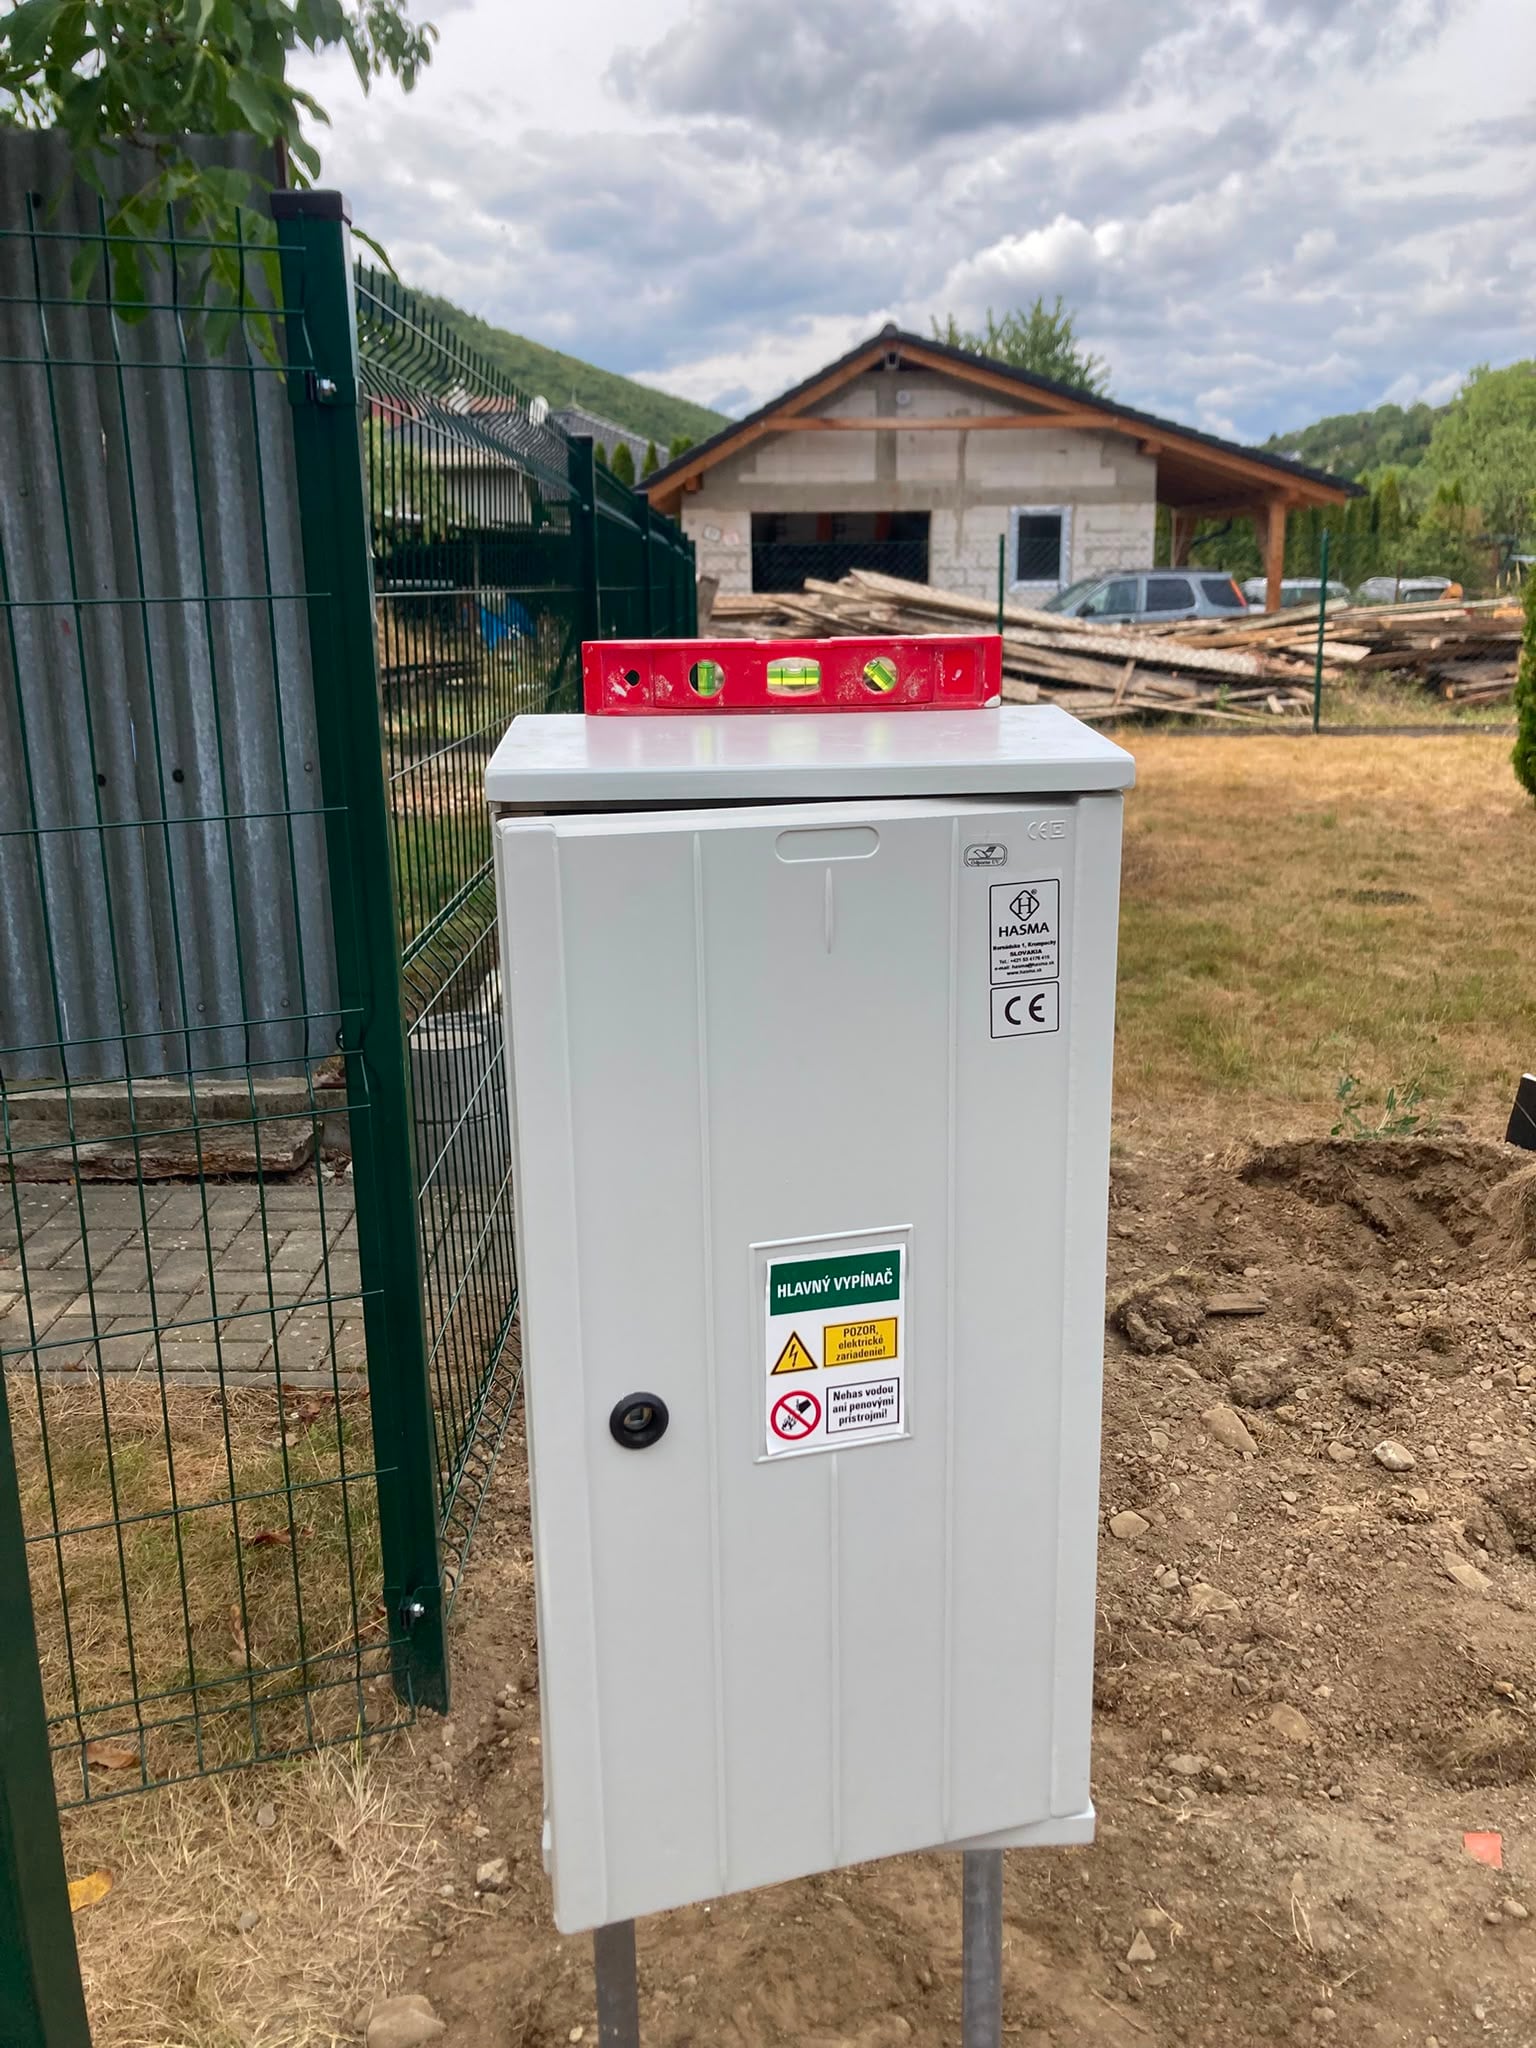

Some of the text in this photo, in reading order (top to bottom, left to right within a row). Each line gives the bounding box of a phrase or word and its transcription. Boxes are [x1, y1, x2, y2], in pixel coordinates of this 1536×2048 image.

[998, 922, 1050, 938] HASMA
[1010, 949, 1042, 957] SLOVAKIA
[1005, 993, 1045, 1025] CE
[777, 1268, 893, 1298] HLAVNÝ VYPÍNAČ
[843, 1324, 879, 1338] POZOR,
[838, 1334, 884, 1350] elektrické
[836, 1346, 886, 1362] zariadenie!
[833, 1385, 894, 1401] Nehas vodou
[832, 1395, 894, 1413] ani penovými
[839, 1410, 888, 1427] prístrojmi!
